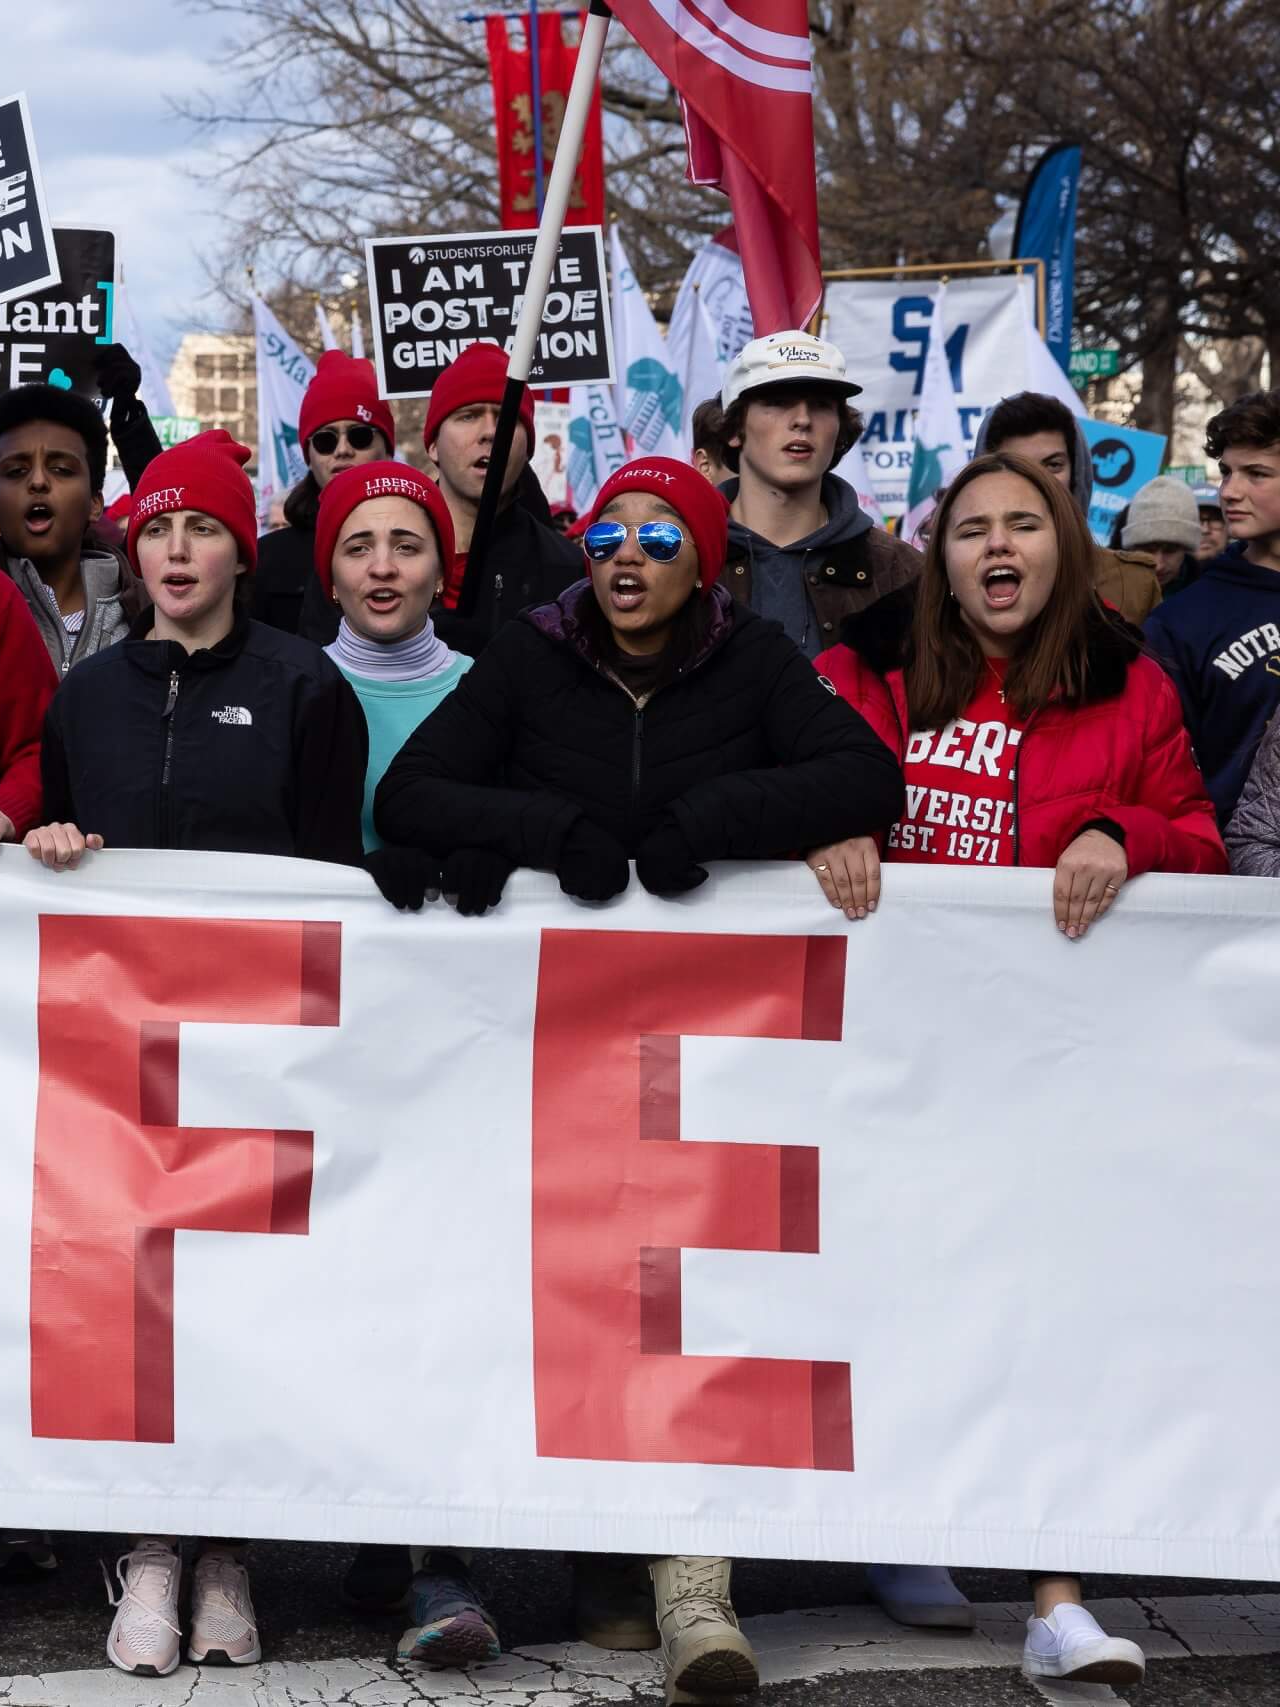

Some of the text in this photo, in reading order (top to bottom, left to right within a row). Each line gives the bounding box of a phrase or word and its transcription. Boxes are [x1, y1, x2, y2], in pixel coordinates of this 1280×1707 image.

[391, 269, 402, 294] I
[422, 264, 485, 292] AM
[356, 404, 373, 422] LU
[1212, 622, 1280, 681] NOTR
[211, 711, 239, 719] NORTH
[224, 705, 239, 713] THE
[888, 823, 1000, 864] EST. 1971
